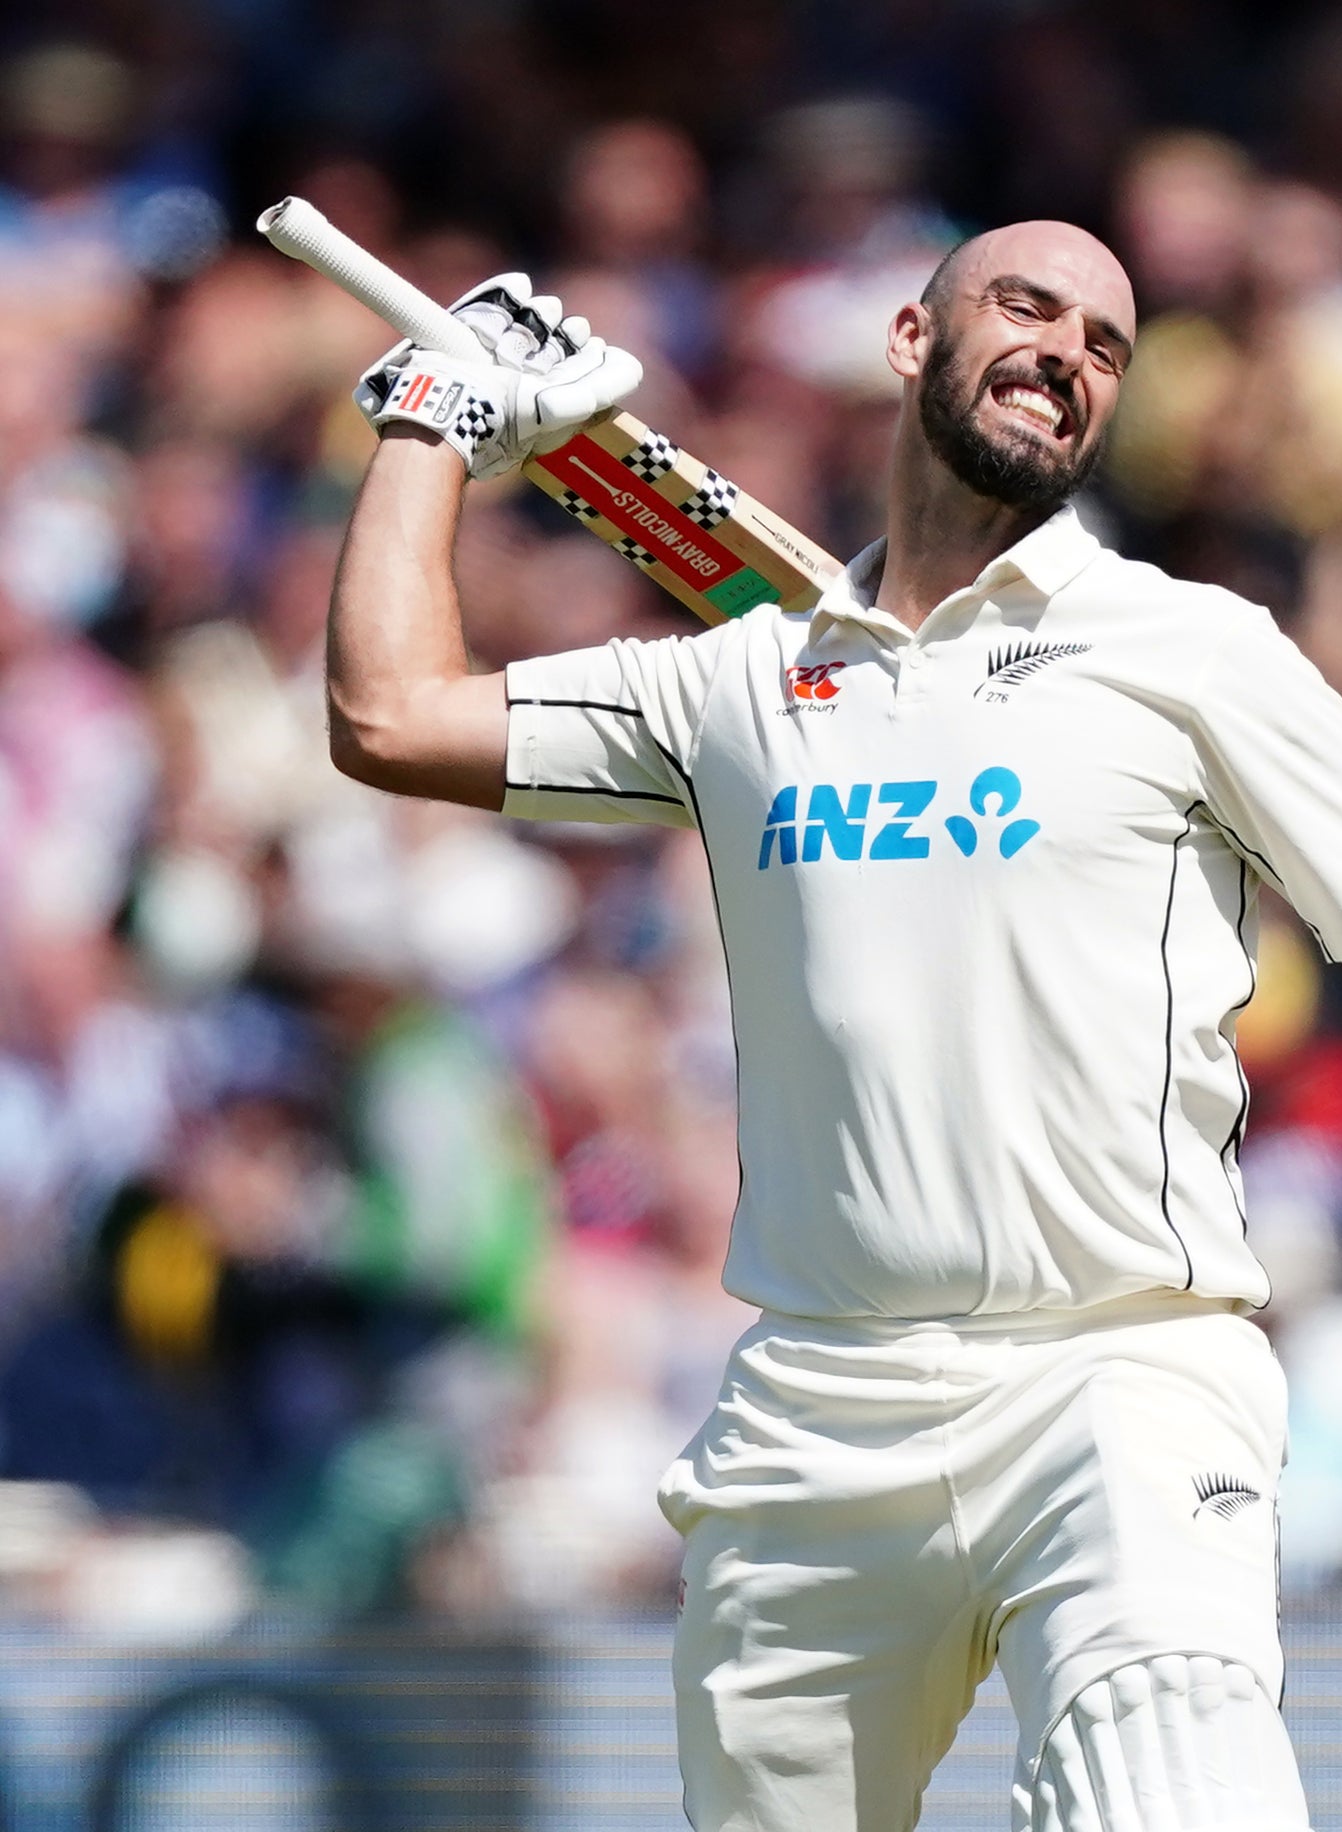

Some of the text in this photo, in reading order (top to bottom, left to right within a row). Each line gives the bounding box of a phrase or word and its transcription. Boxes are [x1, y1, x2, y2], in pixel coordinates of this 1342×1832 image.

[434, 386, 461, 422] SUPRA
[613, 491, 721, 577] GRAY-NICOLLS
[985, 691, 1009, 704] 276
[758, 780, 938, 871] ANZ
